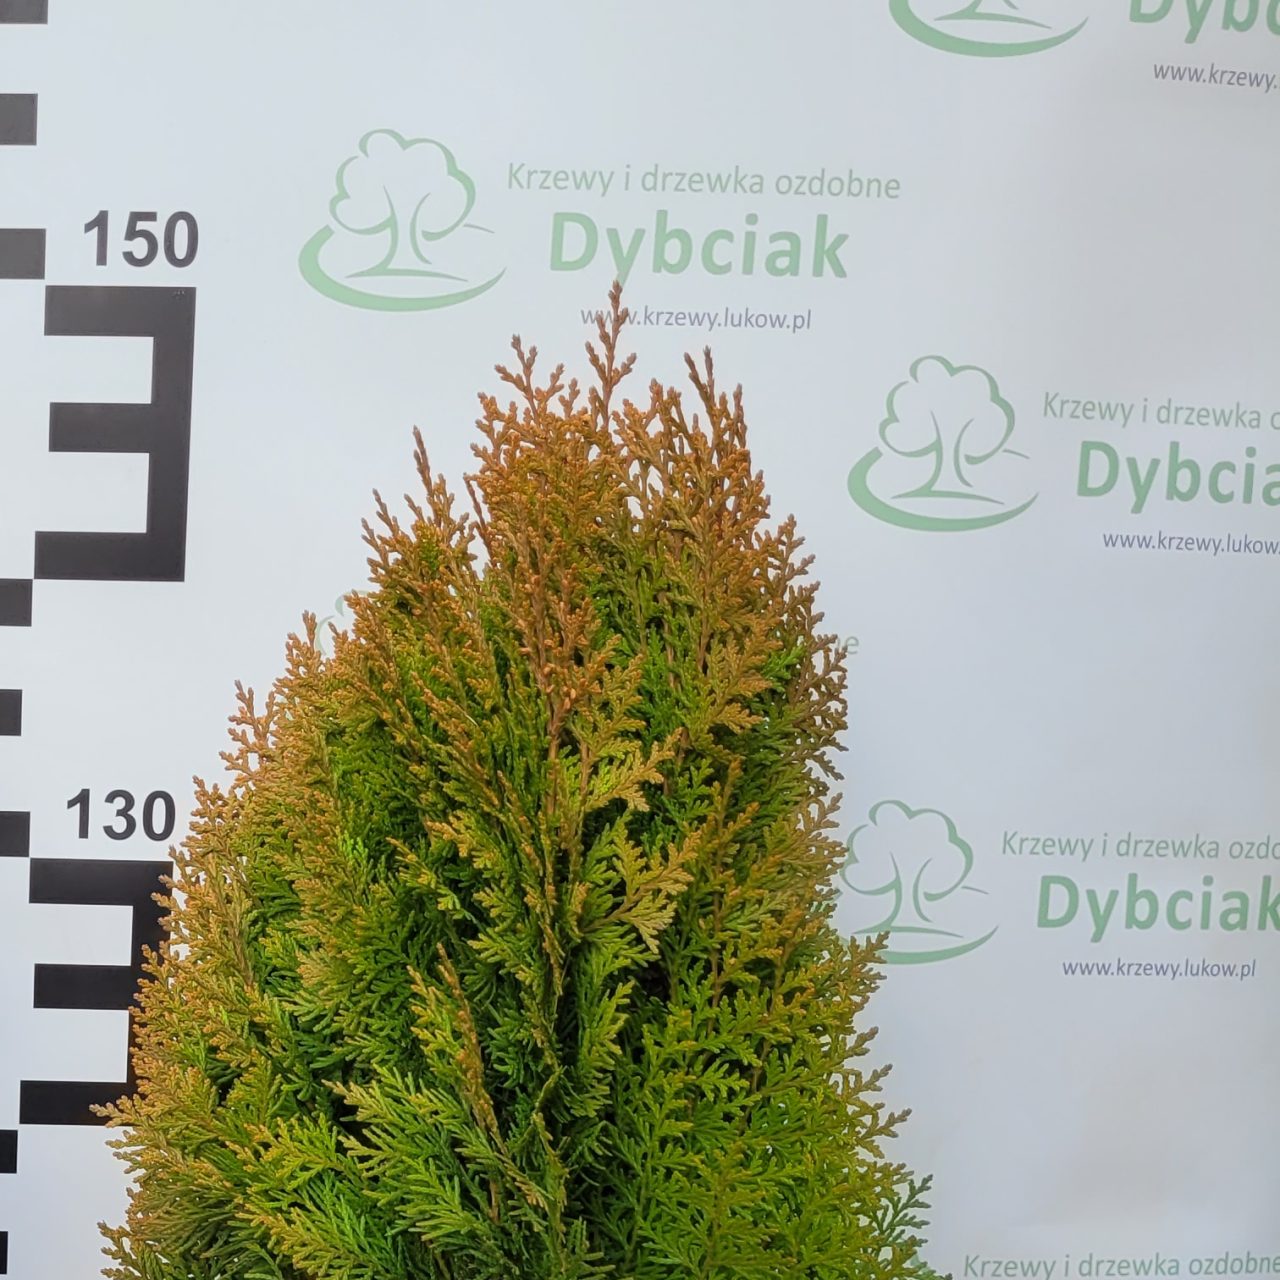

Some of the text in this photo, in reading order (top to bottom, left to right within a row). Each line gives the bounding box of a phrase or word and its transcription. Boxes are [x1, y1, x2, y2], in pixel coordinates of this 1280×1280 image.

[1153, 62, 1280, 94] www.krzewy.
[507, 162, 901, 200] Krzewy i drzewka ozdobne
[83, 209, 199, 269] 150
[549, 208, 851, 287] Dybciak
[1043, 391, 1135, 429] Krzewy
[1141, 397, 1149, 423] i
[1156, 397, 1262, 430] drzewka
[66, 787, 177, 842] 130
[1002, 830, 1095, 861] Krzewy
[1101, 832, 1109, 857] i
[1115, 831, 1220, 859] drzewka
[1036, 872, 1280, 944] Dybciak
[1062, 957, 1257, 982] www.krzewy.lukow.pl
[1063, 1253, 1070, 1278] i
[1078, 1251, 1181, 1278] drzewka
[1188, 1250, 1280, 1276] ozdobne
